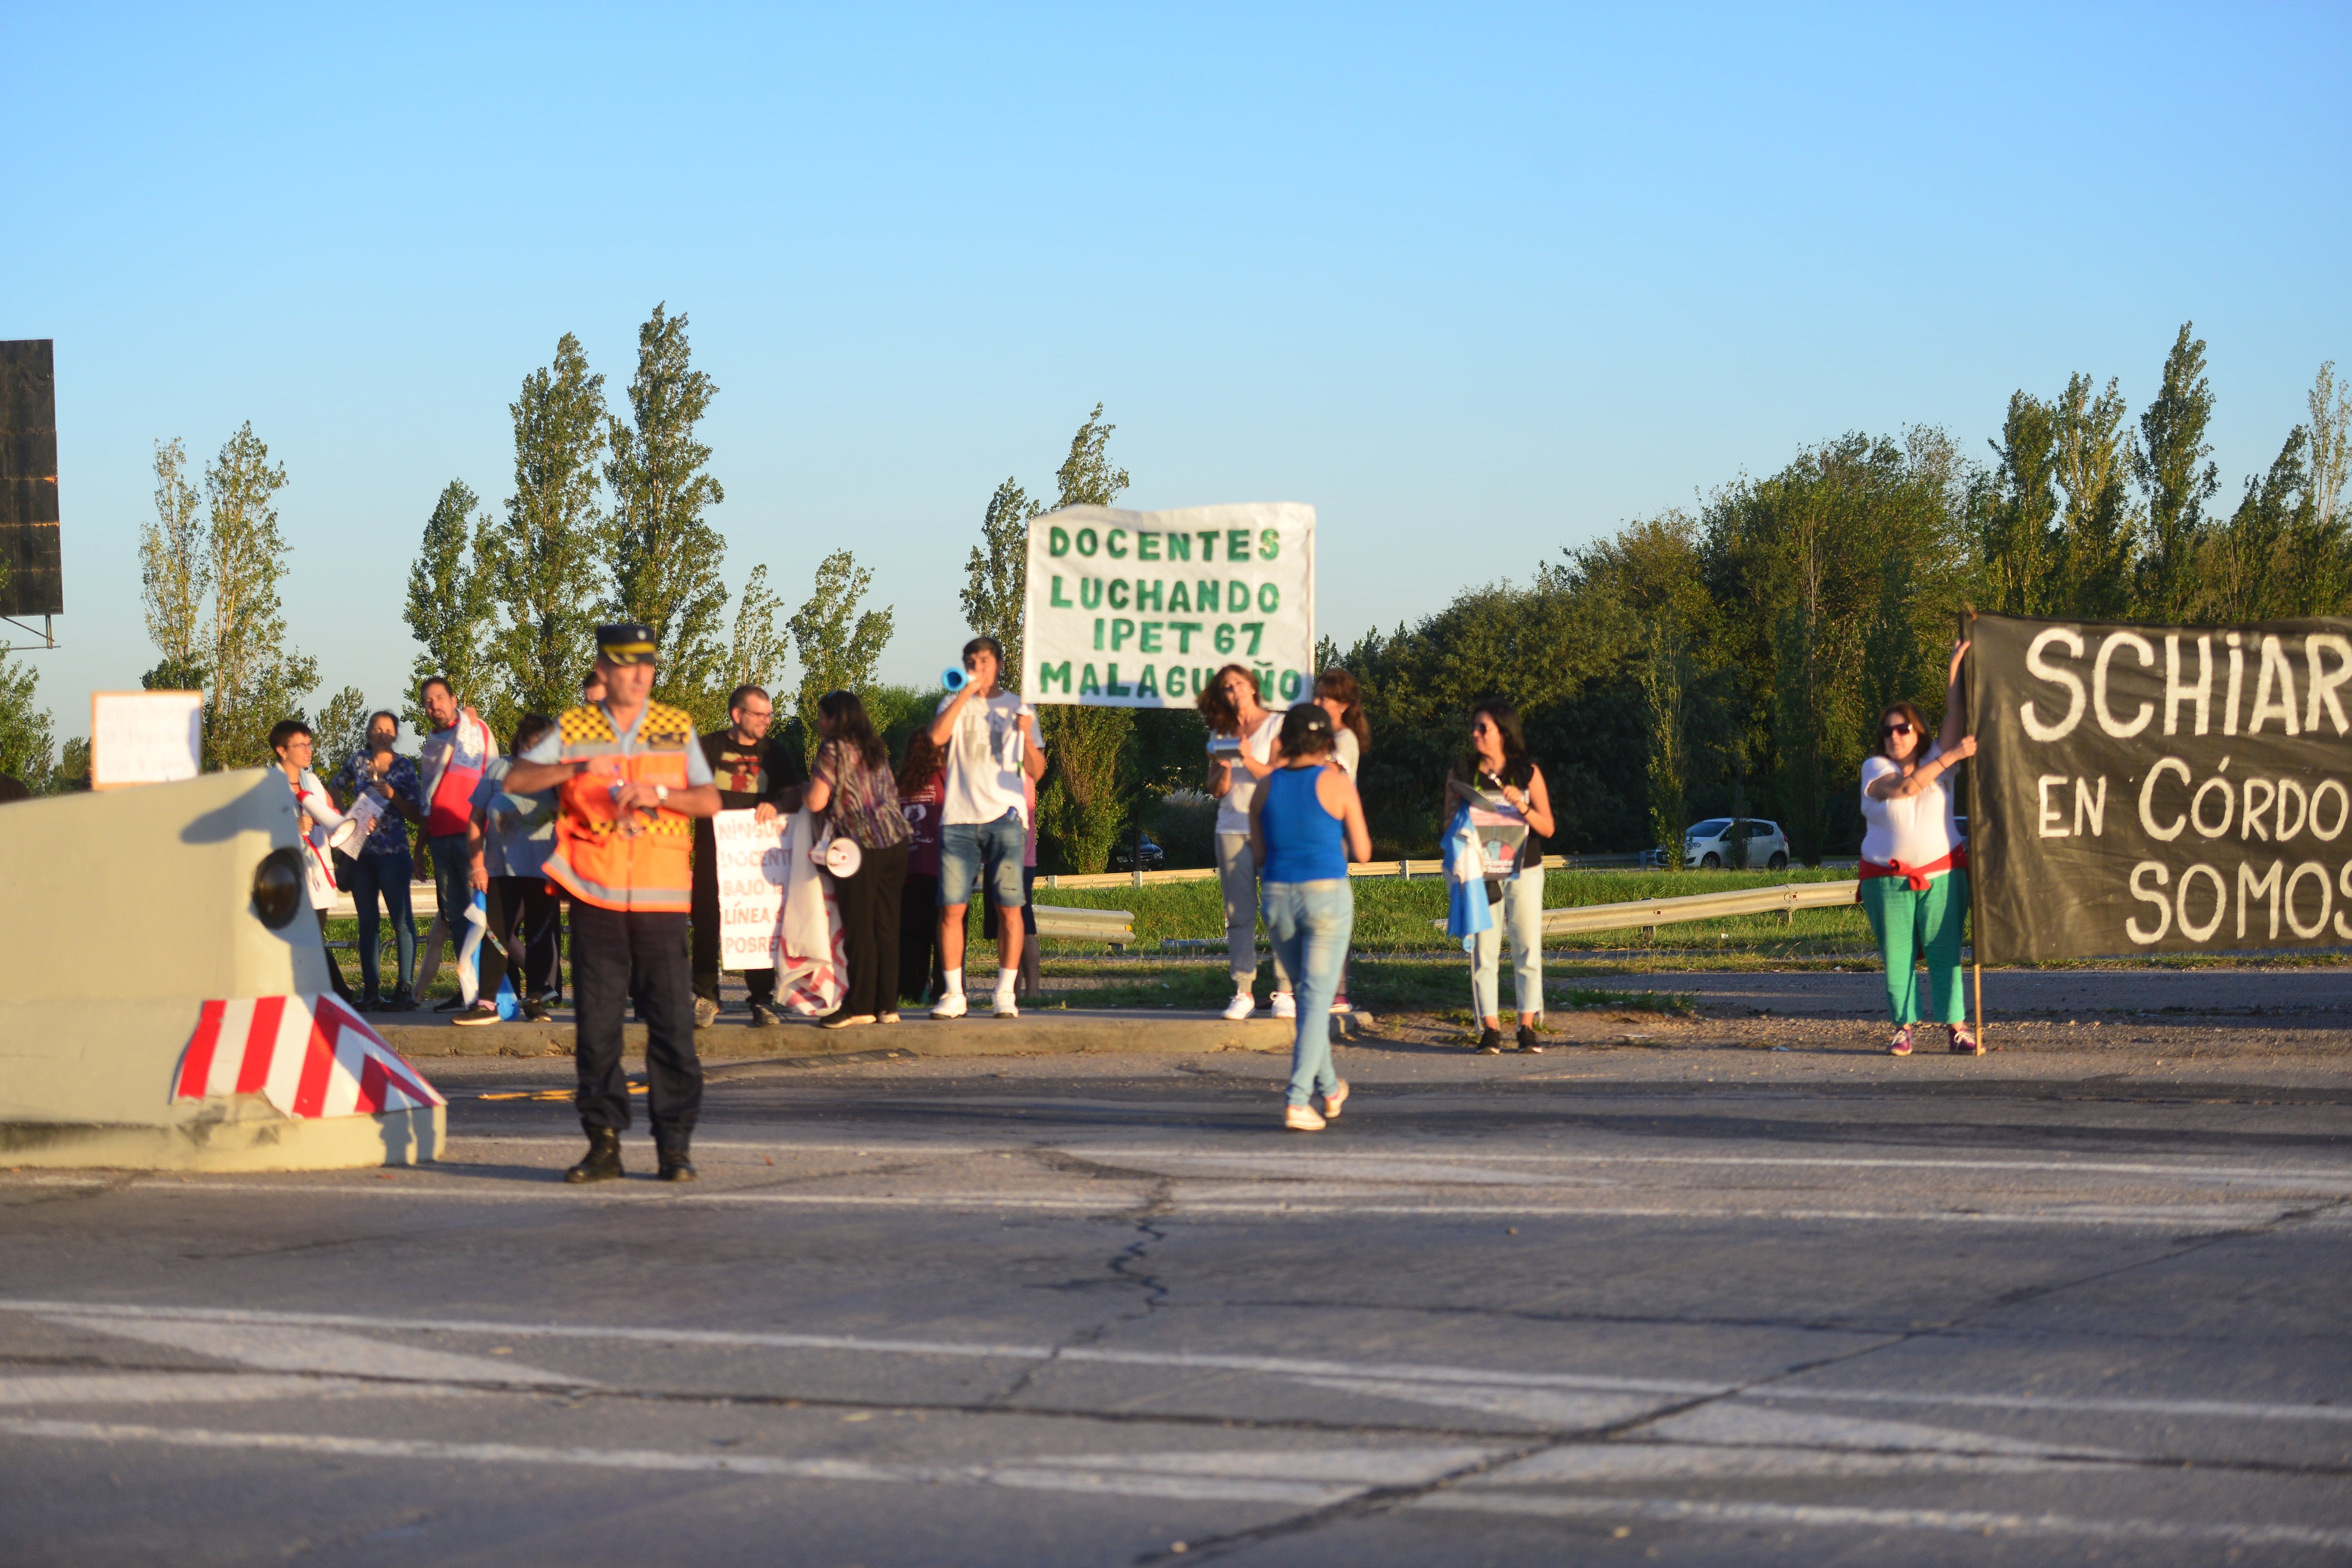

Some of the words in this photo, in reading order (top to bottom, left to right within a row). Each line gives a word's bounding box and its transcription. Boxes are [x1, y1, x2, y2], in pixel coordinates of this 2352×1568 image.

[1049, 526, 1279, 561] DOCENTES
[1050, 576, 1279, 613] LUCHANDO
[1093, 618, 1203, 654] IPET
[1214, 622, 1265, 656] 67
[1040, 661, 1301, 701] MALAGUÑO
[2038, 774, 2107, 838] EN
[2138, 756, 2350, 842] CÓRDO
[723, 879, 765, 896] BAJO
[724, 901, 771, 925] LÍNEA
